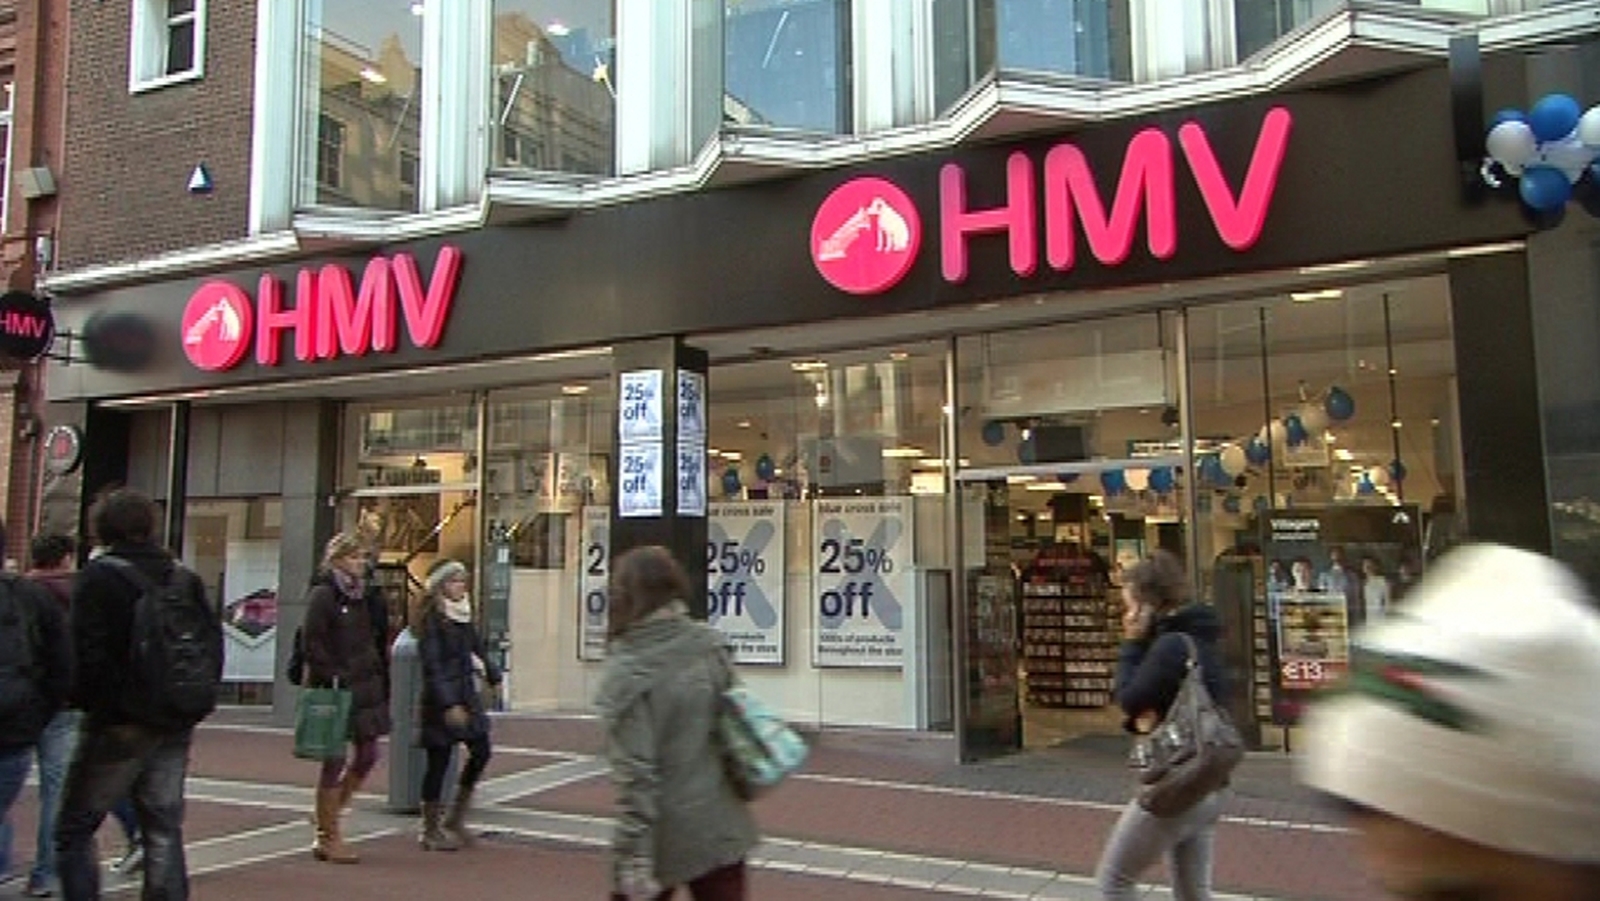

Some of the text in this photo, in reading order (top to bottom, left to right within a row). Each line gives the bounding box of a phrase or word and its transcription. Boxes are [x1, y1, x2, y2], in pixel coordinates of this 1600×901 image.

[939, 106, 1292, 283] HMV
[256, 245, 464, 366] HMV
[0, 312, 47, 338] HMV
[623, 403, 647, 420] off
[623, 476, 646, 493] off
[707, 542, 765, 574] 25%
[820, 539, 894, 574] 25%
[820, 582, 874, 618] off
